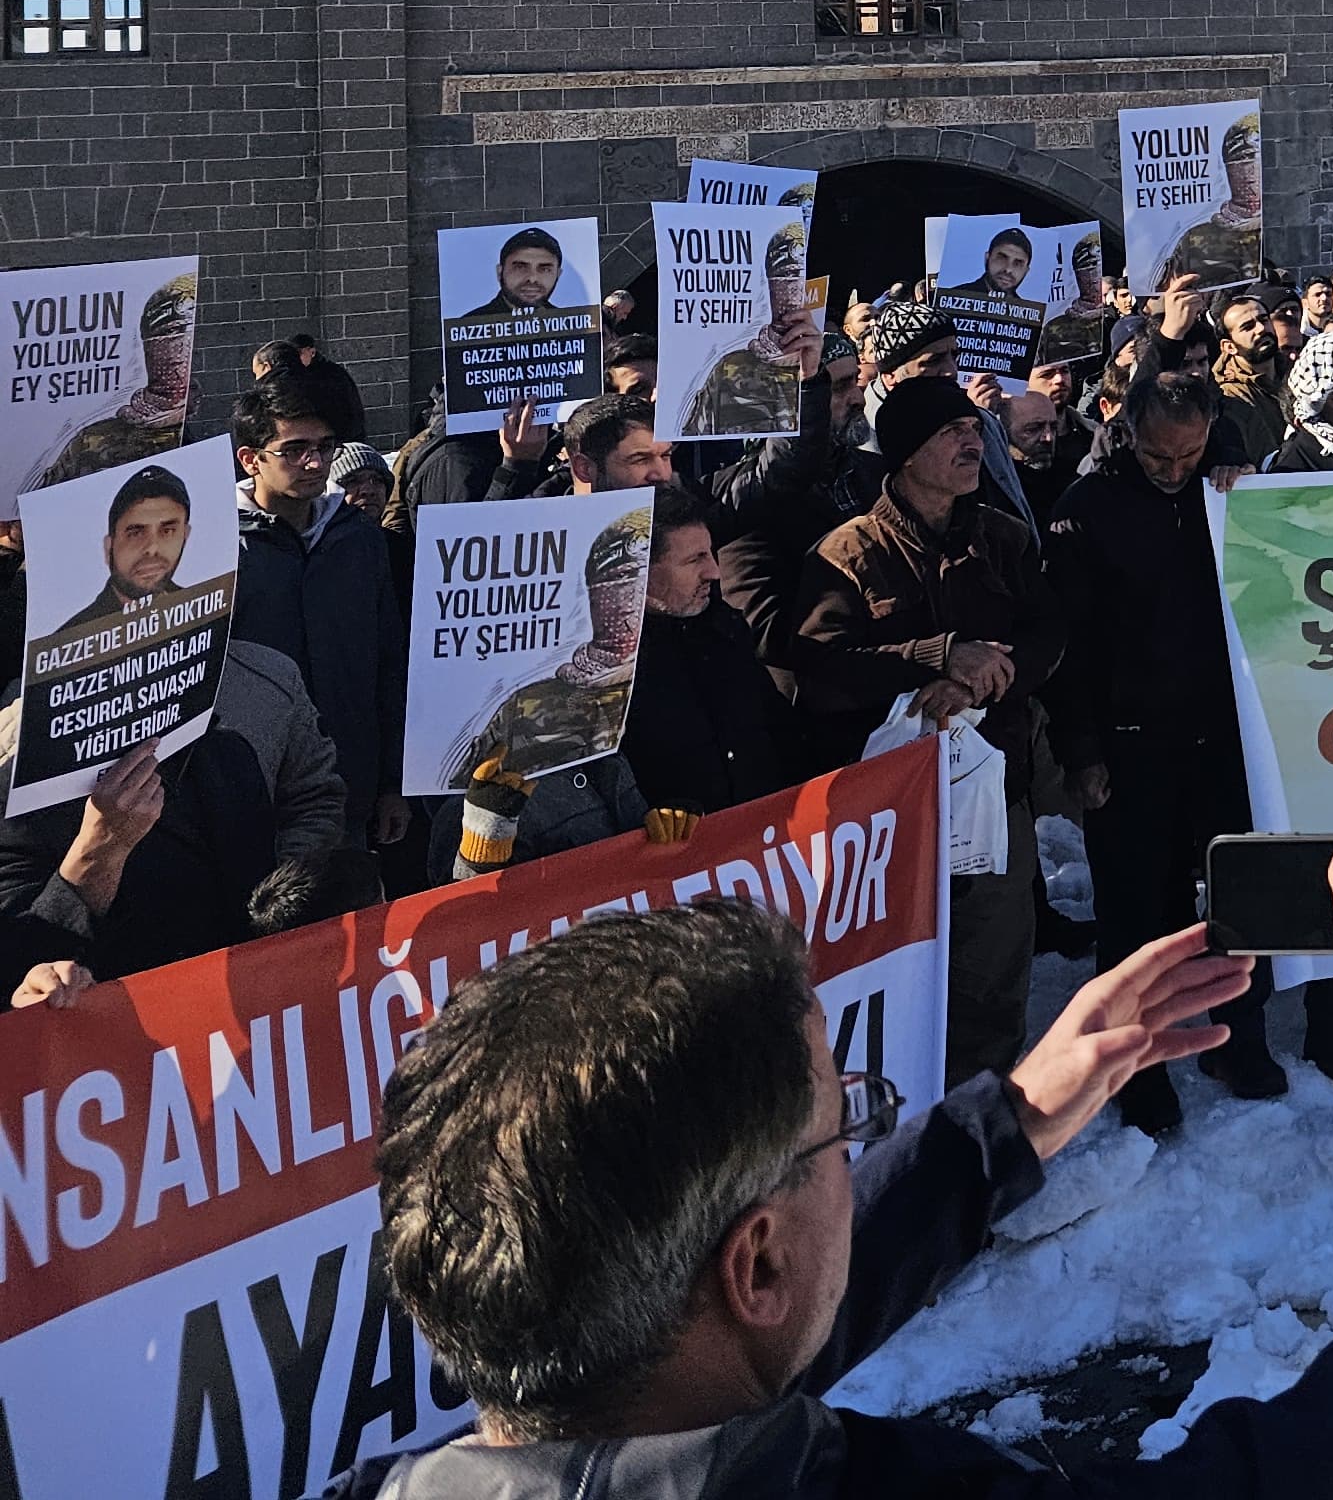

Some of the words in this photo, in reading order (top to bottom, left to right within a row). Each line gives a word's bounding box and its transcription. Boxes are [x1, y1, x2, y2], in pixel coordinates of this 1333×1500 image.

[1131, 125, 1210, 160] YOLUN
[1134, 159, 1210, 183] YOLUMUZ
[1136, 187, 1157, 208] EY
[1161, 181, 1212, 210] ŞEHİT!
[667, 228, 753, 265] YOLUN
[672, 268, 752, 294] YOLUMUZ
[12, 290, 125, 339] YOLUN
[674, 298, 699, 324] EY
[700, 295, 752, 328] ŞEHİT!
[939, 295, 986, 313] GAZZE'DE
[987, 300, 1007, 316] DAĞ
[1008, 304, 1041, 323] YOKTUR.
[450, 320, 512, 342] GAZZE'DE
[514, 317, 540, 335] DAĞ
[542, 314, 597, 333] YOKTUR.
[952, 317, 996, 336] AZZE'NİN
[996, 322, 1032, 340] DAĞLARI
[13, 334, 121, 370] YOLUMUZ
[462, 343, 530, 365] GAZZE'NİN
[532, 338, 585, 359] DAĞLARI
[955, 336, 987, 351] SURCA
[988, 340, 1027, 358] SAVAŞAN
[11, 374, 42, 403] EY
[47, 363, 121, 404] ŞEHİT!
[465, 366, 524, 386] CESURCA
[526, 359, 584, 379] SAVAŞAN
[435, 529, 568, 584] YOLUN
[435, 580, 563, 621] YOLUMUZ
[35, 626, 122, 675] GAZZE'DE
[125, 610, 159, 645] DAĞ
[163, 589, 227, 630] YOKTUR.
[433, 626, 469, 659] EY
[476, 614, 561, 661] ŞEHİT!
[49, 656, 143, 708] GAZZE'NİN
[147, 628, 212, 674] DAĞLARI
[49, 692, 133, 739] CESURCA
[138, 661, 207, 710] SAVAŞAN
[73, 703, 181, 762] YİĞİTLERİDİR.
